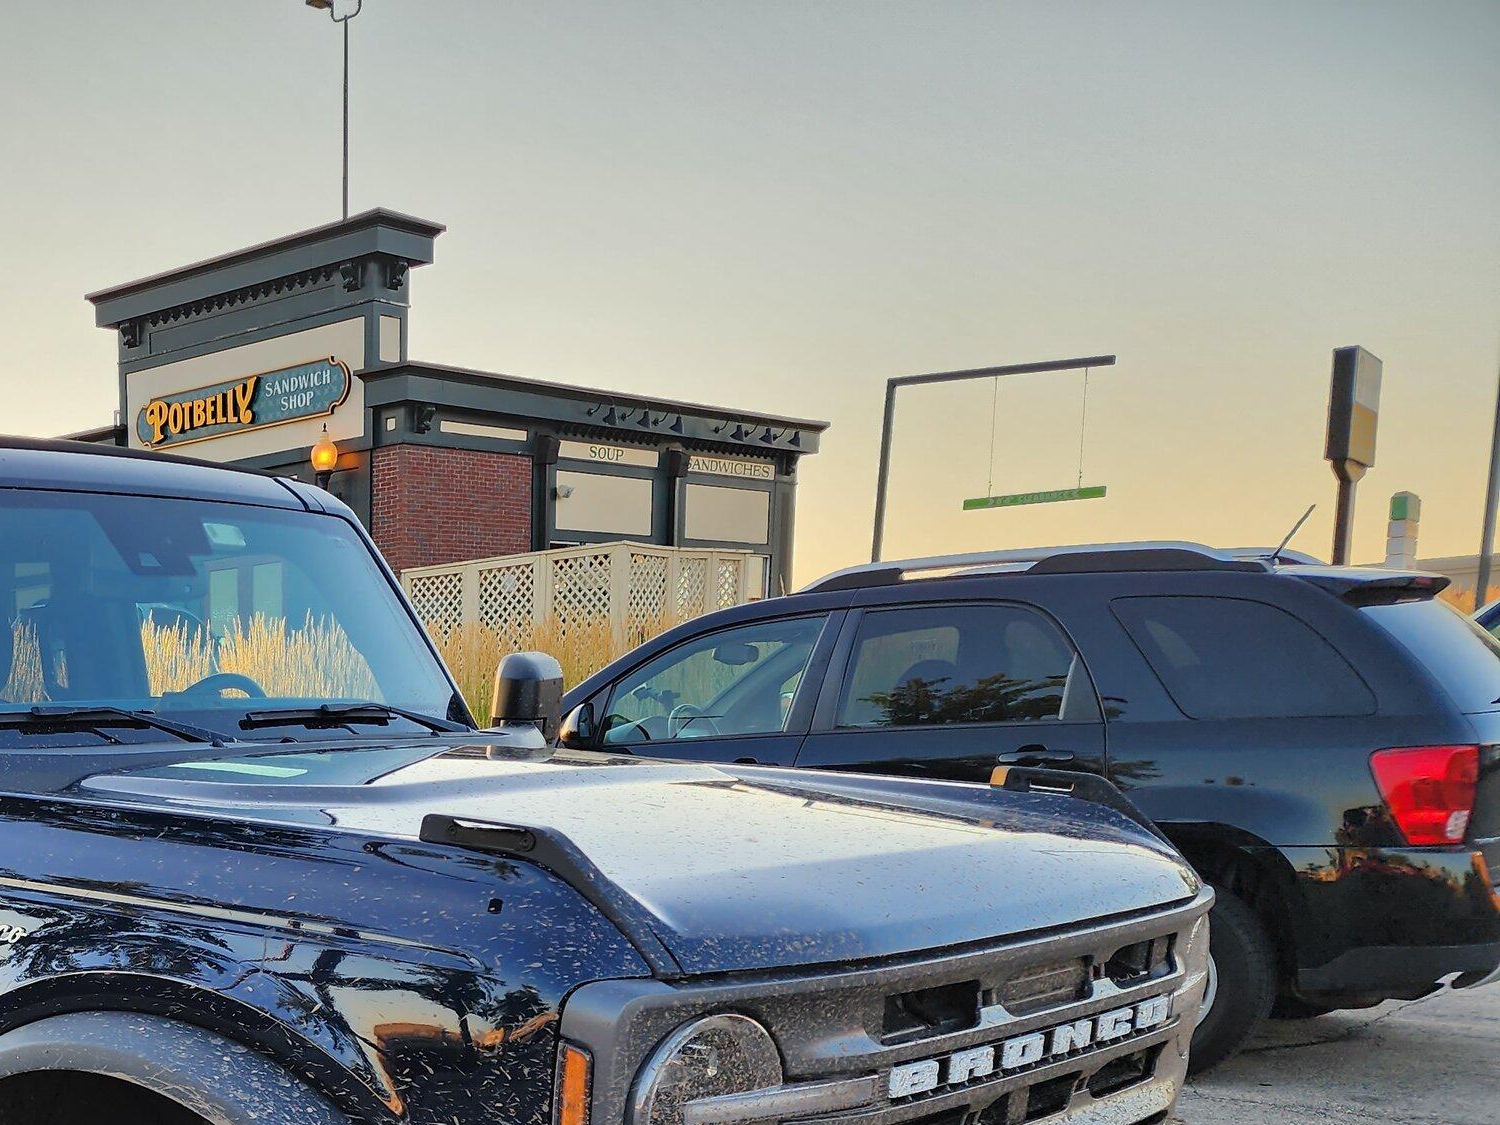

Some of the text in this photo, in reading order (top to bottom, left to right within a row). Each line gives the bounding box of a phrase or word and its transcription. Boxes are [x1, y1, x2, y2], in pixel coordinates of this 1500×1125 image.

[265, 369, 331, 397] SANDWICH
[146, 375, 258, 444] POTBELLY
[280, 391, 314, 411] SHOP
[589, 446, 624, 461] SOUP
[888, 995, 1169, 1099] BRONCO
